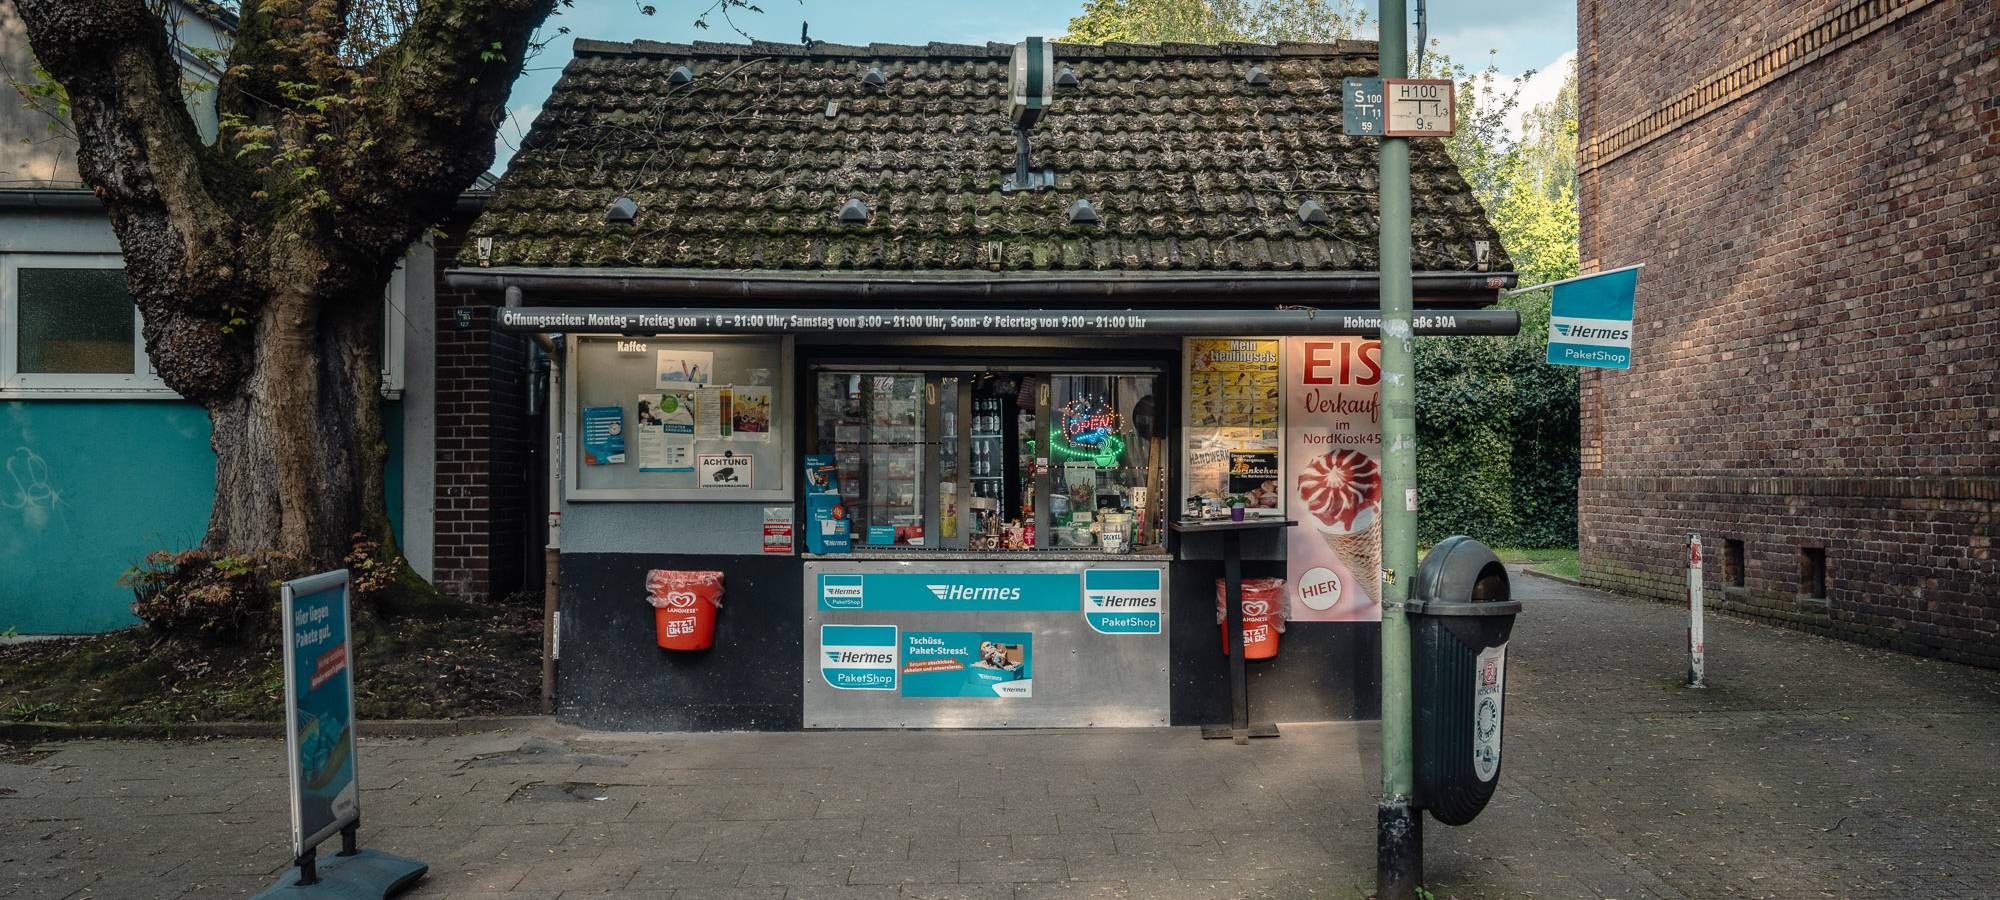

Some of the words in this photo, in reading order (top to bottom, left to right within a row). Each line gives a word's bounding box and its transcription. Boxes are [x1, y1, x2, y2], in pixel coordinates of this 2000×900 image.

[1366, 94, 1382, 103] 100
[503, 310, 585, 328] Öffnungszeiten:
[588, 313, 627, 328] Montag
[639, 314, 676, 329] Freitag
[678, 316, 697, 327] von
[734, 315, 763, 327] 21:00
[766, 315, 788, 329] Uhr,
[790, 315, 834, 330] Samstag
[837, 317, 856, 328] von
[893, 315, 922, 328] 21:00
[925, 315, 947, 330] Uhr,
[950, 316, 980, 328] Sonn-
[982, 316, 993, 328] &
[995, 315, 1037, 330] Feiertag
[1040, 317, 1059, 328] von
[1061, 315, 1085, 328] 9:00
[1096, 315, 1125, 328] 21:00
[1128, 315, 1147, 328] Uhr
[1434, 316, 1456, 328] 30A
[1570, 325, 1629, 340] Hermes
[617, 341, 647, 352] Kaffee
[1230, 340, 1257, 351] Mein
[1211, 350, 1277, 364] Lieblingseis
[1565, 348, 1626, 364] PaketShop
[1302, 341, 1381, 386] EIS
[1305, 388, 1381, 423] Verkauf
[1069, 415, 1111, 434] OPEN
[1335, 420, 1350, 431] im
[1303, 433, 1381, 445] NordKiosk45
[703, 458, 748, 466] ACHTUNG
[948, 584, 1021, 600] Hermes
[1302, 580, 1337, 599] HIER
[1104, 595, 1157, 607] Hermes
[295, 607, 309, 626] Hier
[309, 604, 329, 623] liegen
[1101, 617, 1157, 628] PaketShop
[295, 629, 318, 649] Pakete
[319, 623, 332, 645] gut.
[909, 636, 945, 646] Tschüss,
[841, 651, 893, 664] Hermes
[837, 672, 893, 686] PaketShop
